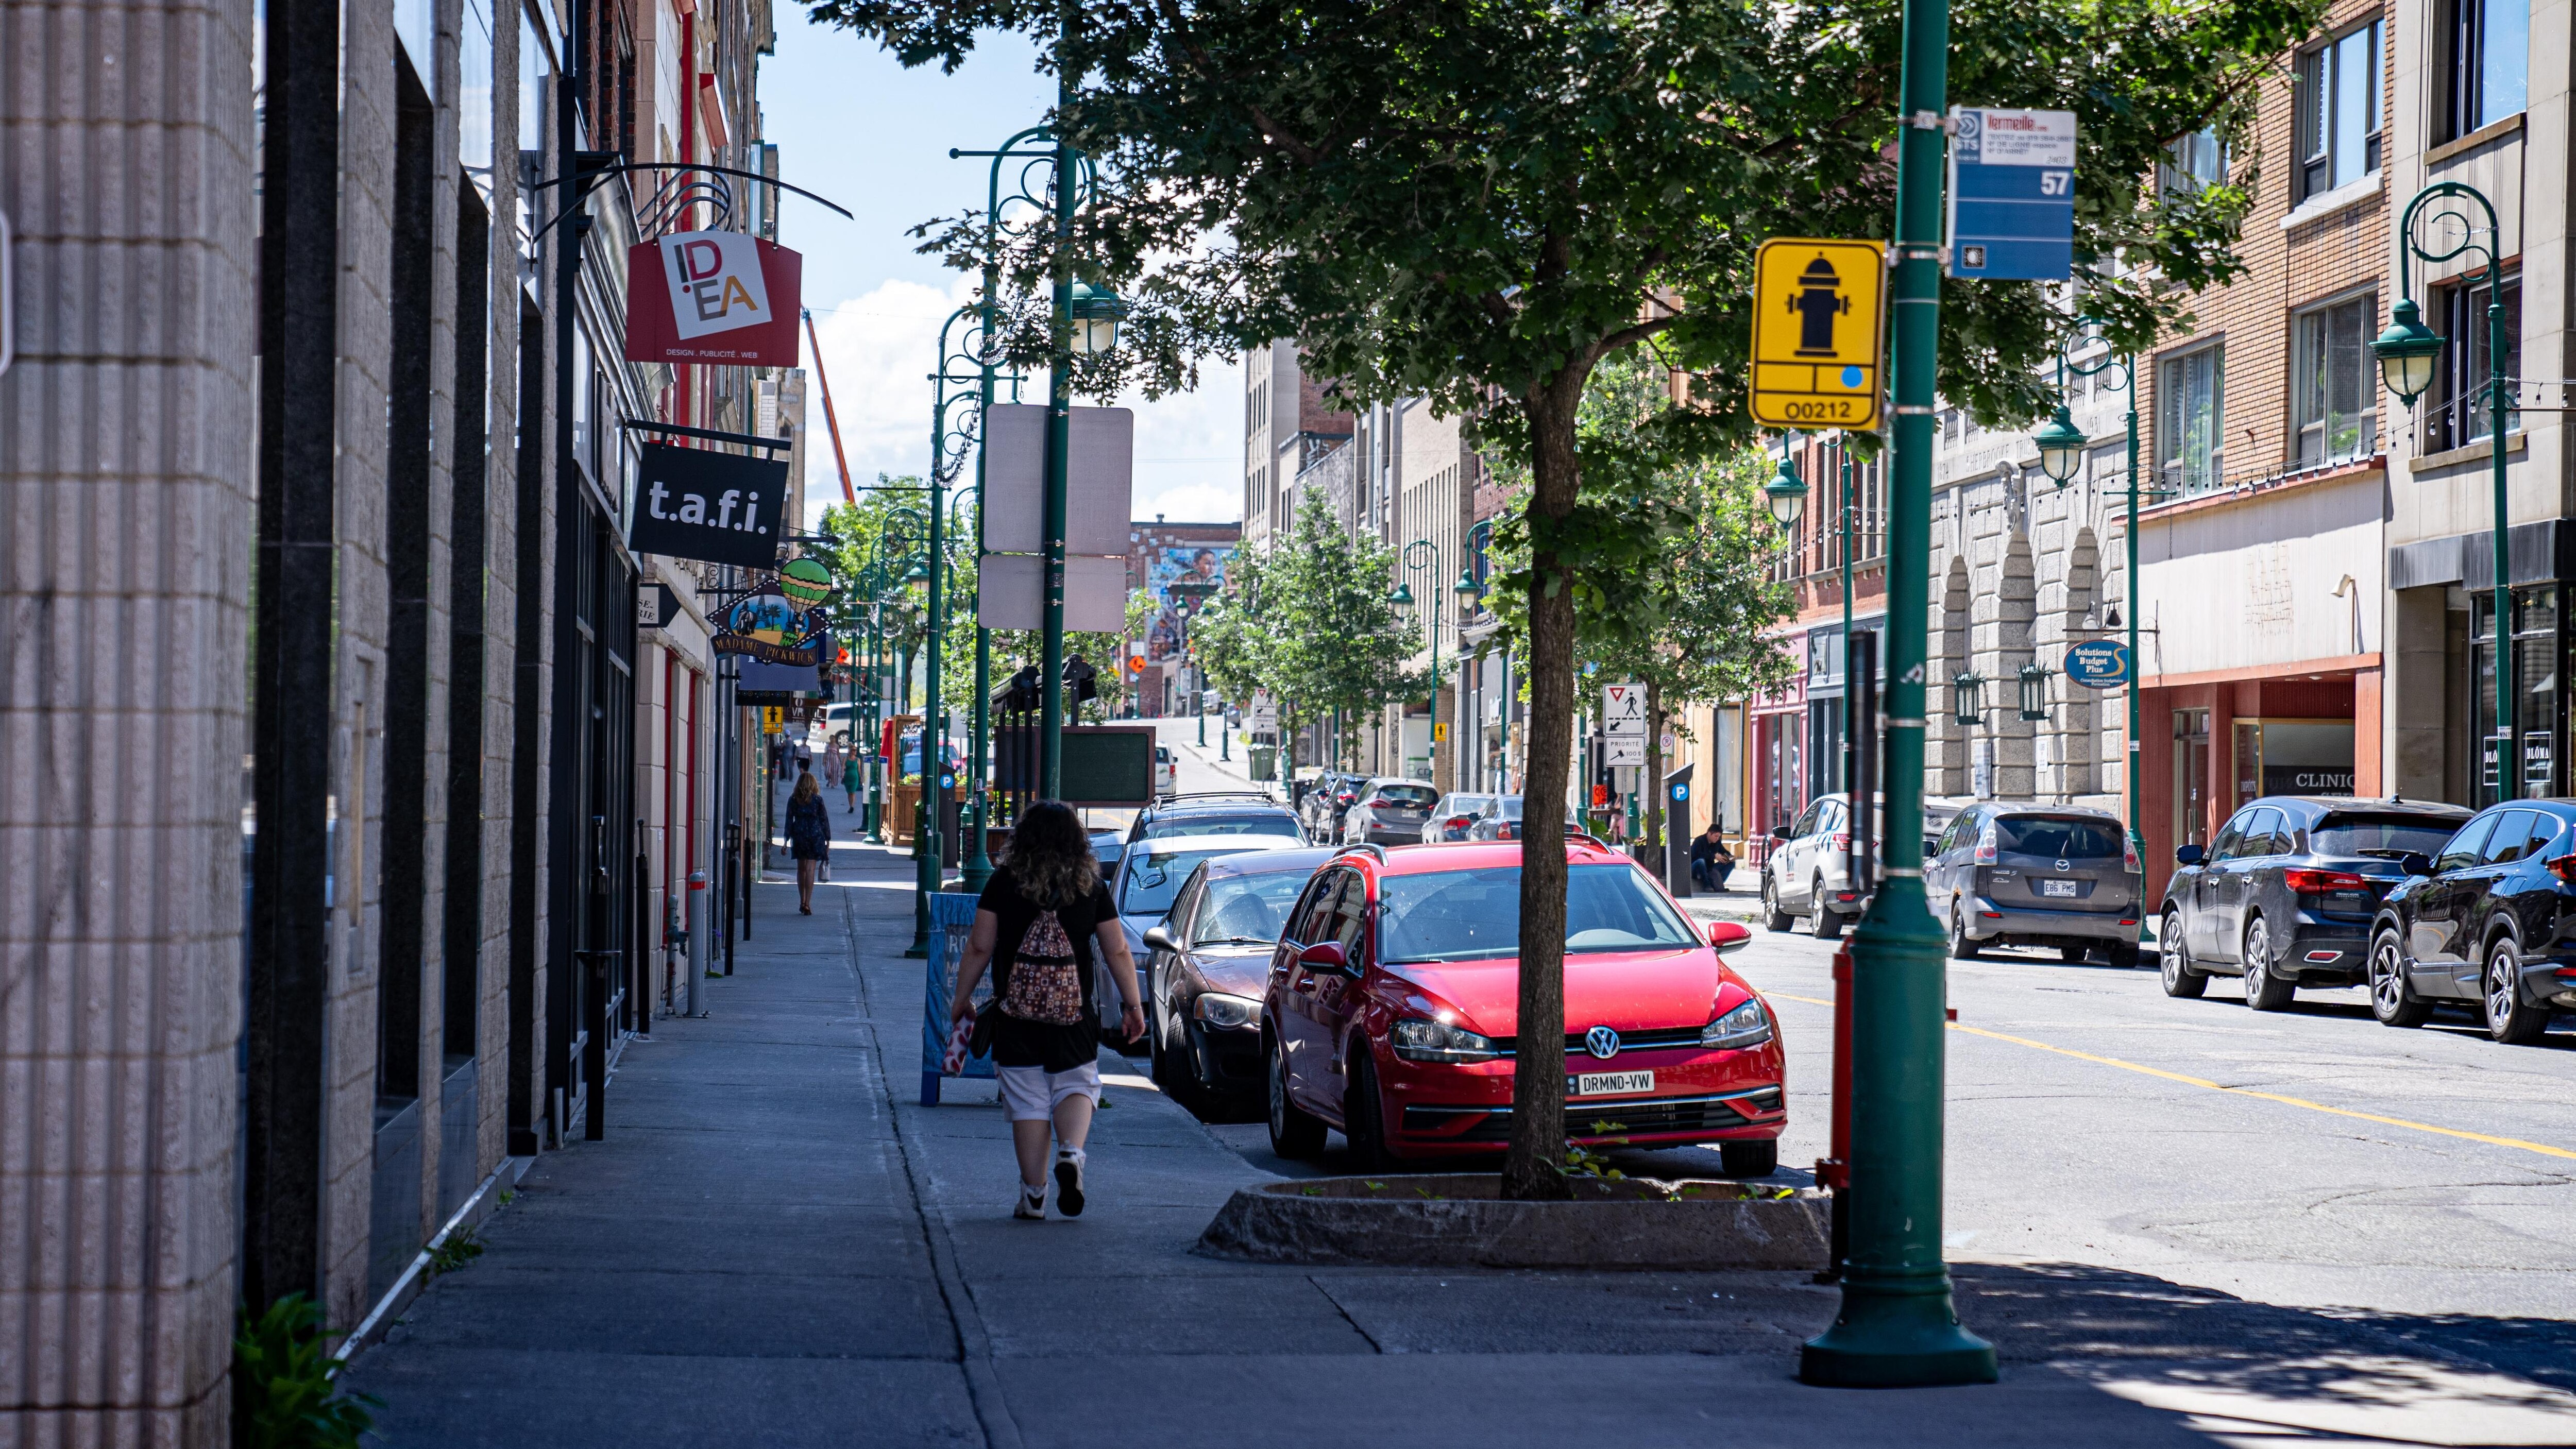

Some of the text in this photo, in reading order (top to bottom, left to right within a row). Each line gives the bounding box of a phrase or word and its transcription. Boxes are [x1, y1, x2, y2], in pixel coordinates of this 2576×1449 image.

[1987, 114, 2036, 132] Vermeille
[2041, 171, 2071, 195] 57
[649, 481, 767, 534] t.a.f.i.
[716, 639, 759, 653] MADAME
[765, 646, 814, 662] PICKWICK
[2075, 648, 2112, 656] Solutions
[2079, 657, 2108, 666] Budget
[2062, 884, 2075, 893] PMS
[1584, 1074, 1649, 1092] DRMND-VW
